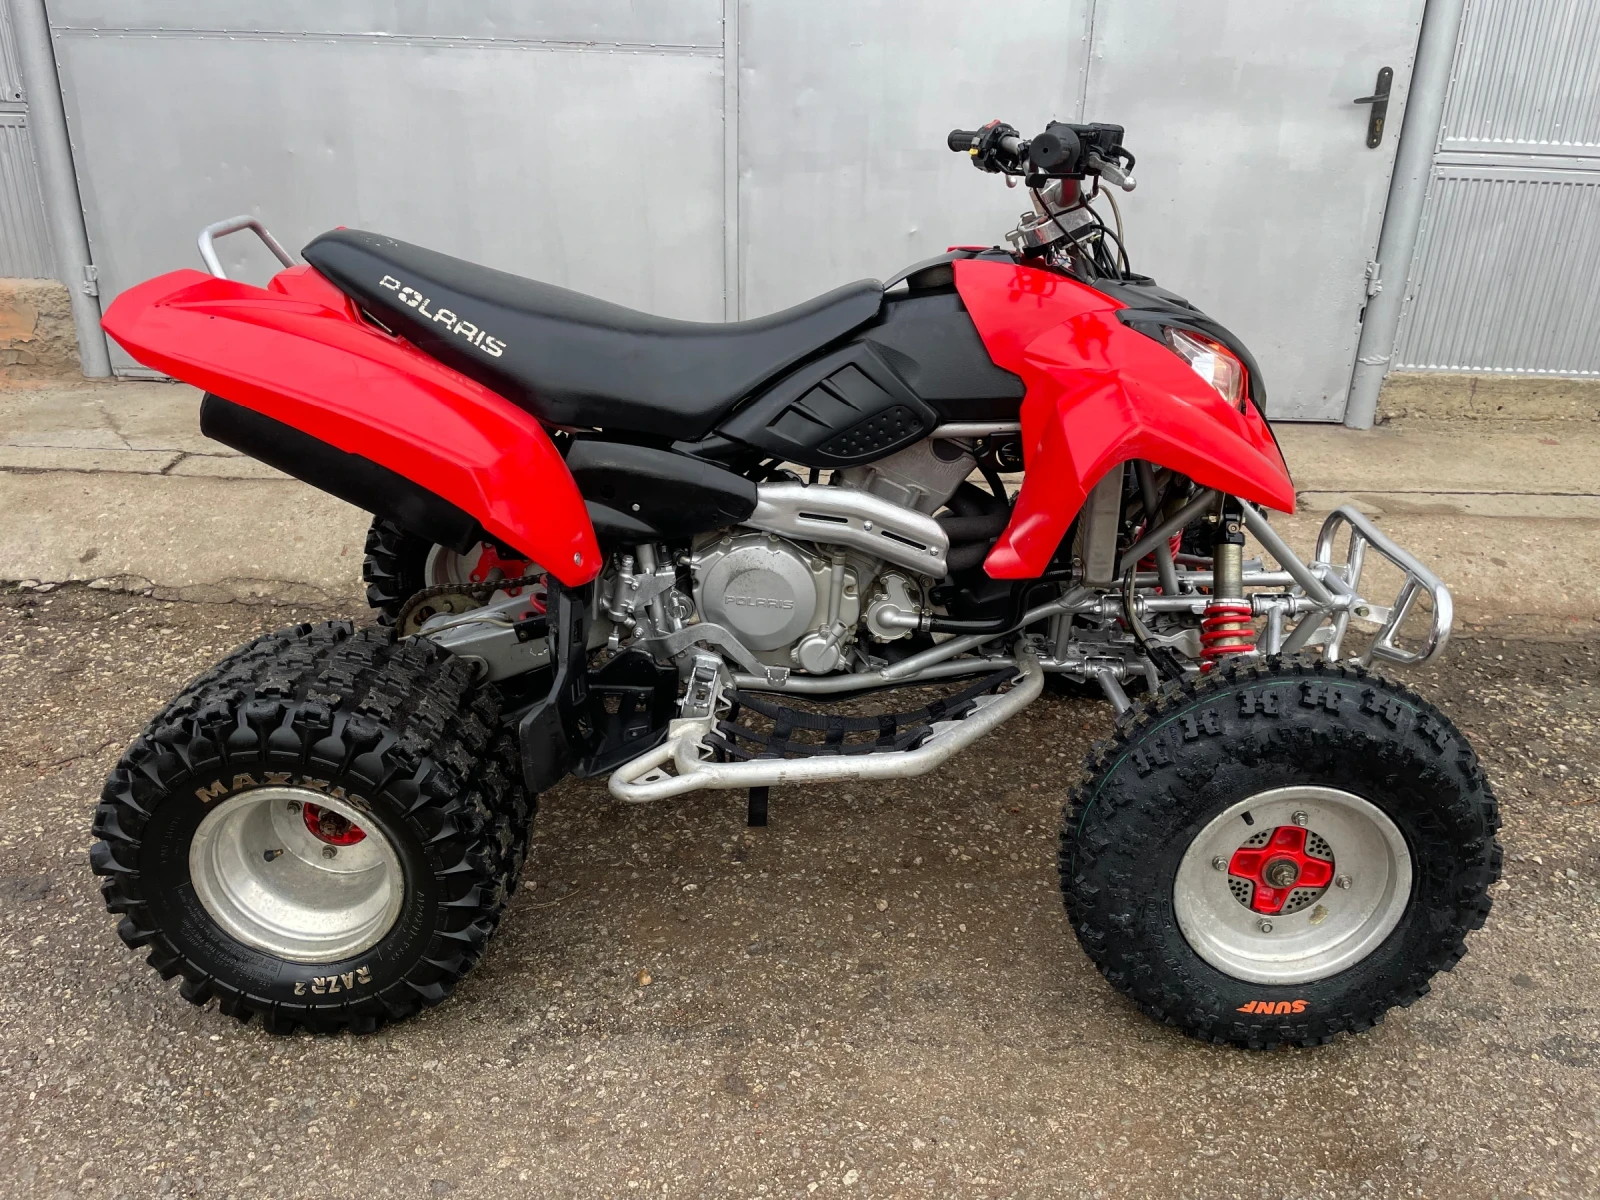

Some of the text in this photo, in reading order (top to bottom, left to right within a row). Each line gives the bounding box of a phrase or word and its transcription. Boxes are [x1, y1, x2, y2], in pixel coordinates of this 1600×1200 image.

[379, 275, 507, 357] POLARIS
[724, 595, 794, 609] POLARIS
[293, 965, 373, 996] RAZR 2
[1236, 1000, 1310, 1015] SUNF
